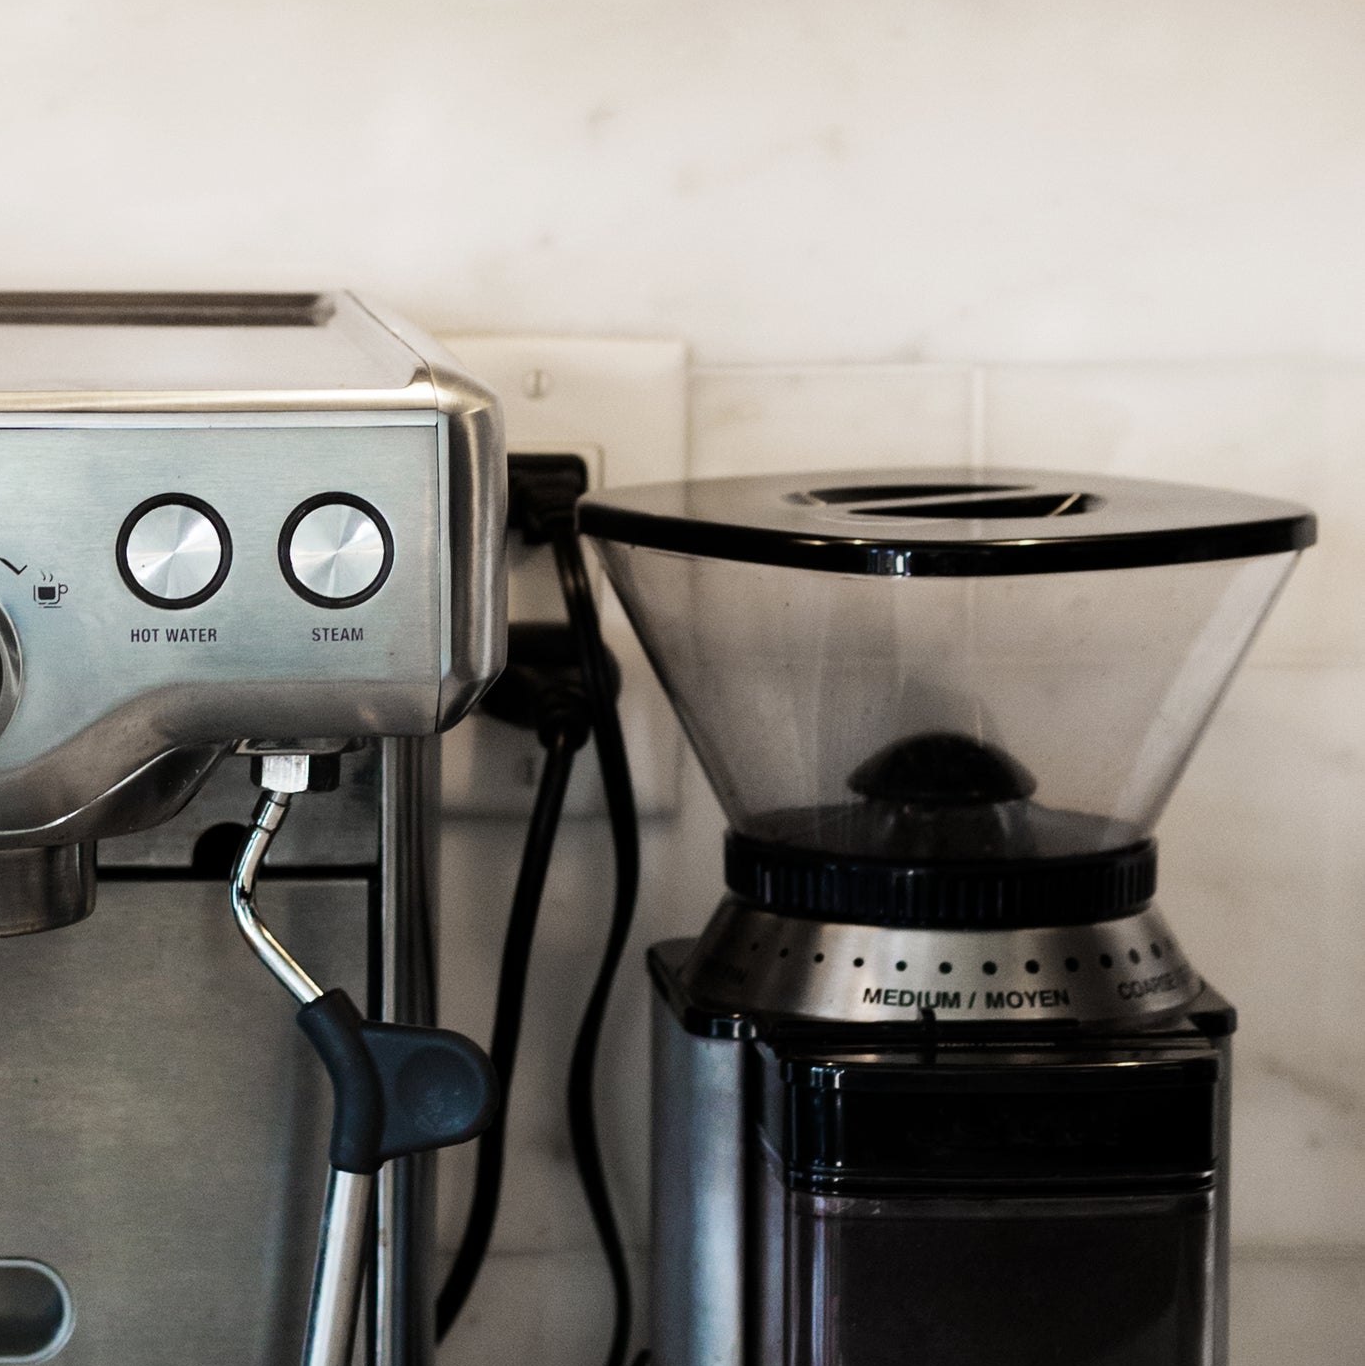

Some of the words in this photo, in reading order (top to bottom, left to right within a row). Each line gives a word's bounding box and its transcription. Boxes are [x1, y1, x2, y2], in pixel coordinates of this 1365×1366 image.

[130, 628, 160, 643] HOT
[165, 628, 218, 643] WATER
[311, 627, 364, 642] STEAM
[862, 988, 961, 1009] MEDIUM
[986, 989, 1070, 1010] MOYEN
